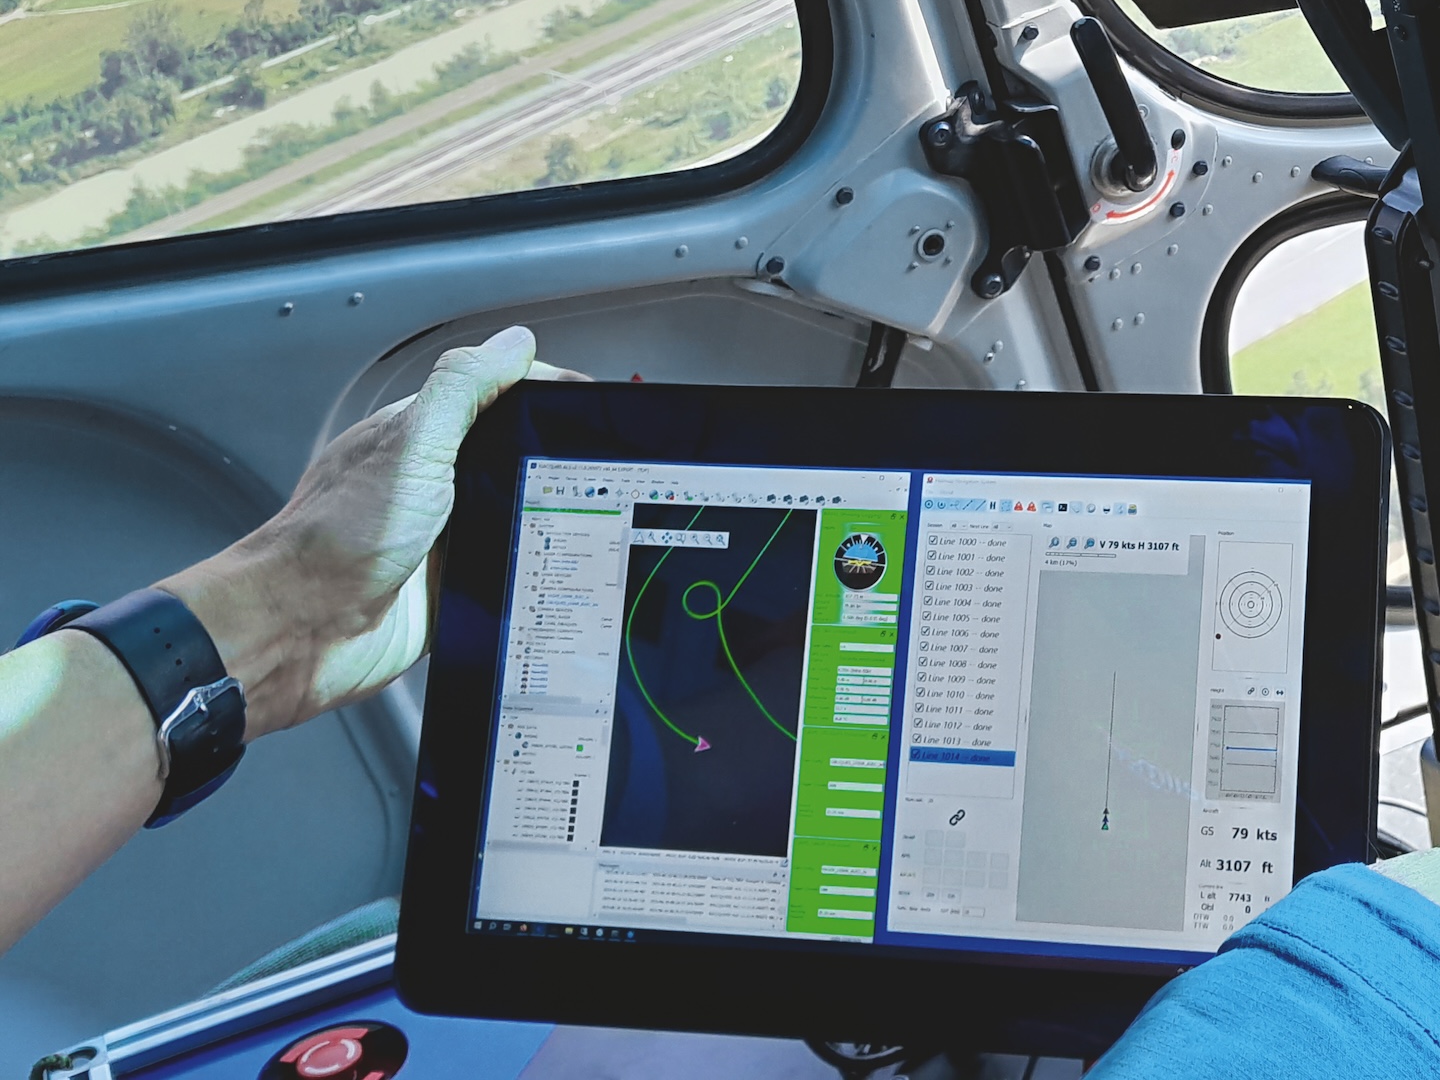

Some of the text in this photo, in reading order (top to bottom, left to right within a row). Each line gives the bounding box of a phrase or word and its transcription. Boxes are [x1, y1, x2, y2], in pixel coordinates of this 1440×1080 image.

[939, 537, 1007, 547] Line 1000 done
[1100, 540, 1180, 551] V 79 kts H 3107 ft
[957, 553, 975, 562] 1001
[986, 554, 1005, 563] done
[937, 568, 1004, 578] Line 1002 done
[936, 583, 1003, 593] Line 1003 done
[954, 599, 972, 608] 1004
[983, 600, 1002, 609] done
[933, 614, 1001, 624] Line 1005 done
[932, 629, 1000, 639] Line 1006 done
[931, 644, 998, 655] Line 1007 done
[930, 660, 997, 670] Line 1008 done
[929, 675, 996, 686] Line 1009 done
[927, 690, 995, 701] Line 1010 done
[926, 706, 994, 716] Line 1011 done
[925, 721, 993, 732] Line 1012 done
[924, 736, 991, 747] Line 1013 done
[1201, 826, 1278, 841] GS 79 kts
[1200, 859, 1273, 873] Alt 3107 ft
[1229, 893, 1251, 902] 7743
[1245, 906, 1251, 914] 0
